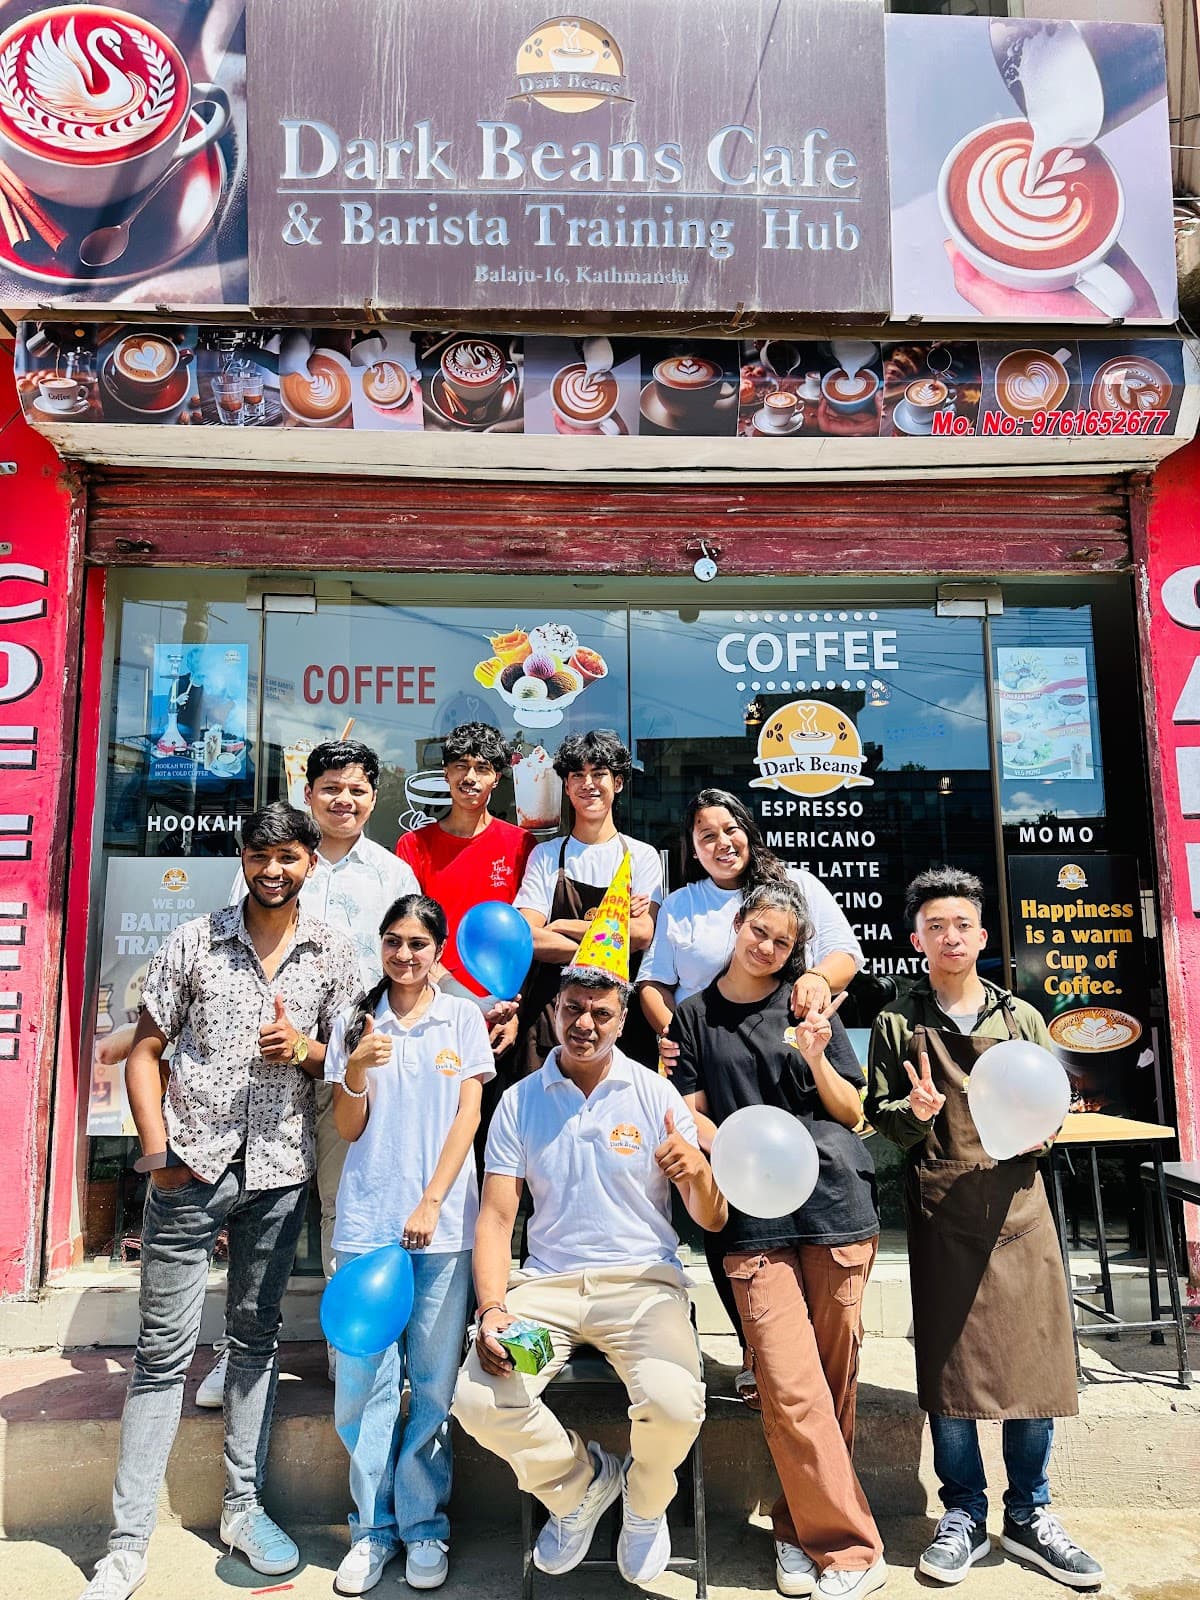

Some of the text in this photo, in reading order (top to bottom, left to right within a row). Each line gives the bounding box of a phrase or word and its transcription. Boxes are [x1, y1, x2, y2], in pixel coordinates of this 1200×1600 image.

[518, 74, 622, 94] Dark Beans
[279, 118, 858, 188] Dark Beans Cafe
[281, 201, 861, 260] & Barista Training Hub
[474, 264, 690, 286] Balaju-16, Kathmandu
[48, 392, 71, 401] Coffee
[931, 410, 1170, 436] Mo. No: 9761652677
[717, 631, 900, 674] COFFEE
[303, 664, 436, 705] COFFEE
[763, 756, 859, 777] Dark Beans
[761, 800, 864, 817] ESPRESSO
[147, 815, 242, 832] HOOKAH
[766, 831, 876, 848] MERICANO
[1019, 826, 1094, 843] MOMO
[818, 861, 880, 878] LATTE
[152, 898, 196, 910] WE DO
[1021, 898, 1134, 923] Happiness
[851, 923, 893, 940] CHA
[1025, 924, 1133, 944] is a warm
[860, 957, 931, 975] CHIATO
[1045, 949, 1118, 973] Cup of
[1044, 975, 1123, 995] Coffee.
